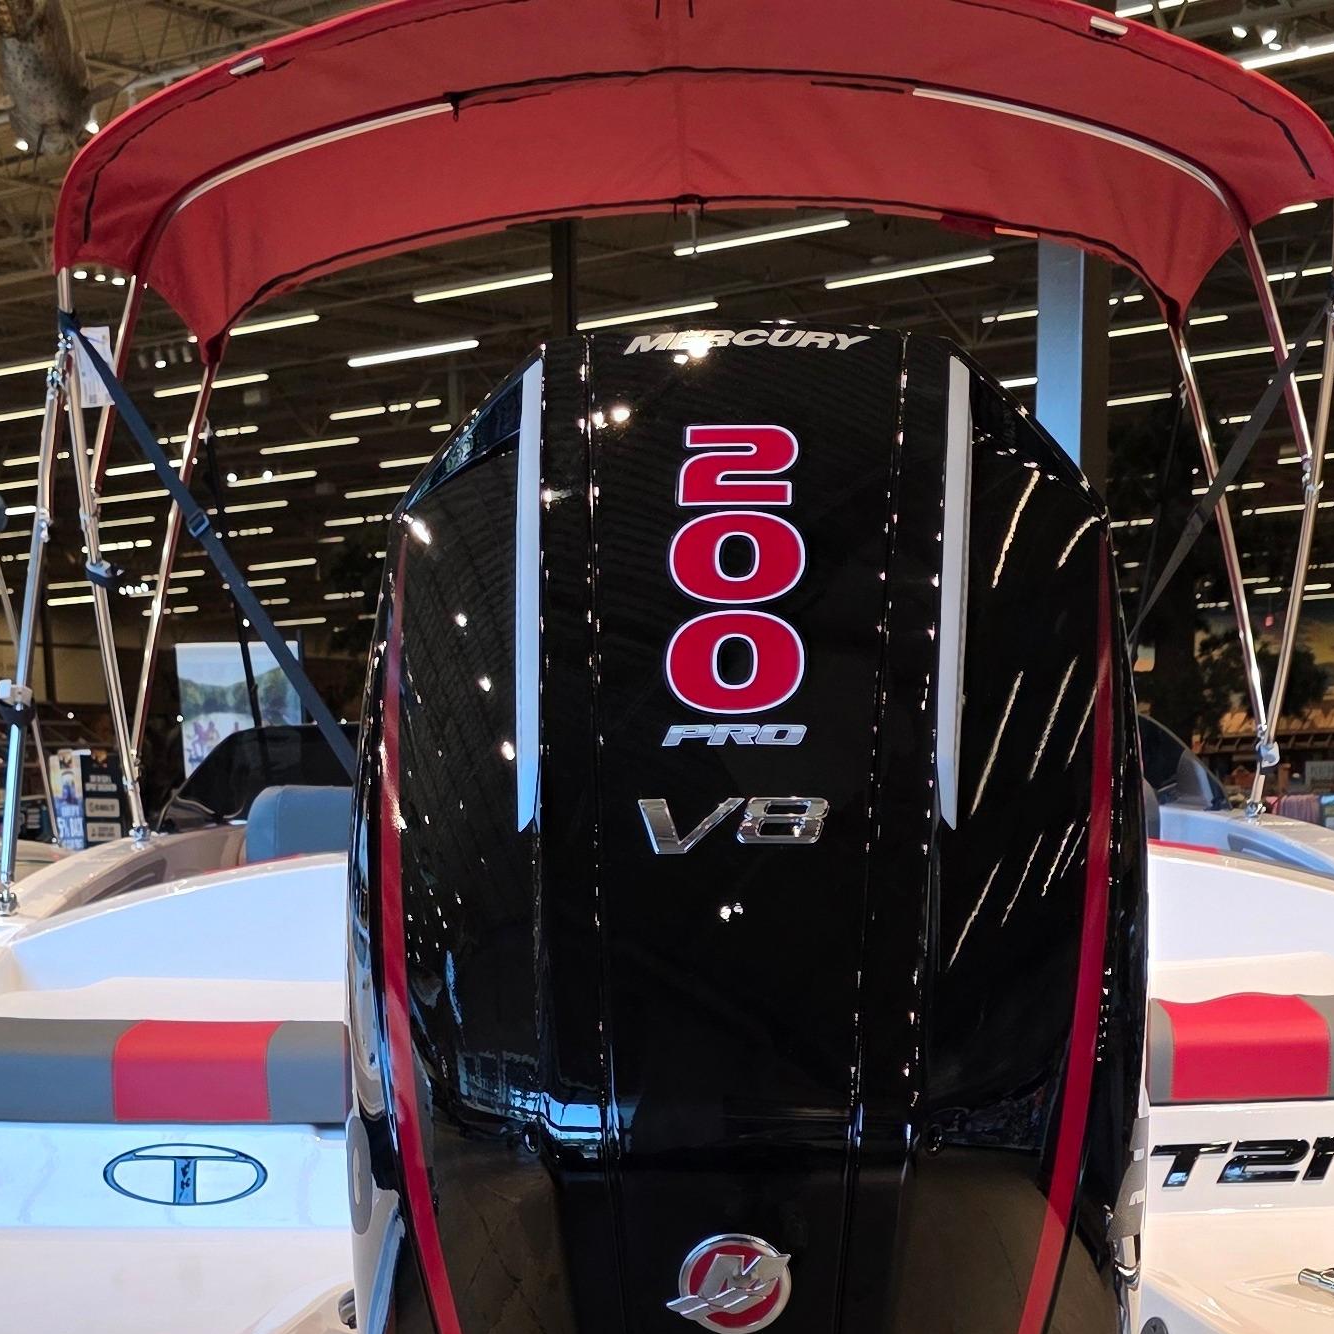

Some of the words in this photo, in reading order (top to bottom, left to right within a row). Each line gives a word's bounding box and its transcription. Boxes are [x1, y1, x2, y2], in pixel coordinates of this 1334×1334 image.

[624, 329, 871, 356] MERCURY
[666, 424, 806, 714] 200
[662, 724, 808, 746] PRO
[638, 796, 830, 855] V8
